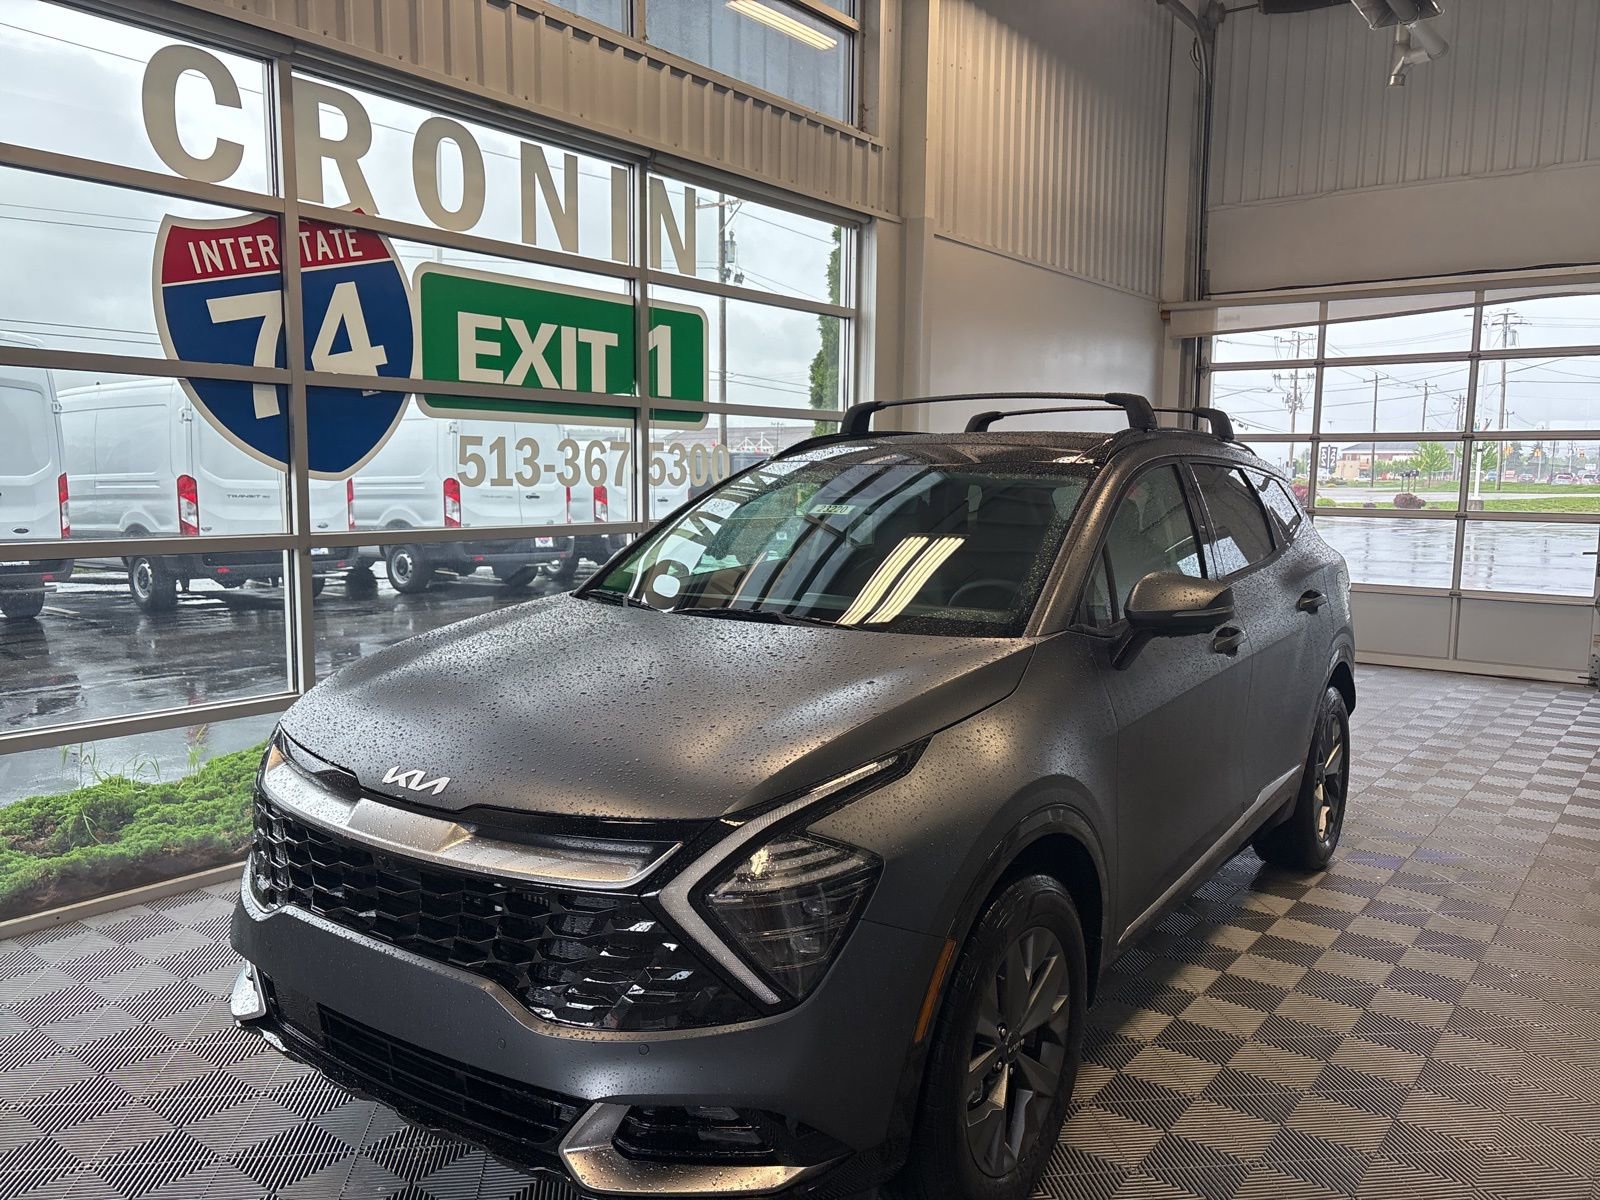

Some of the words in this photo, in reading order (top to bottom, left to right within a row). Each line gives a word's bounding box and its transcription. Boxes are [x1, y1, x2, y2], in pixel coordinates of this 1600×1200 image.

[142, 44, 697, 276] CRONIN
[187, 228, 364, 275] INTERTATE
[205, 281, 389, 420] 74
[457, 311, 619, 394] EXIT
[648, 324, 672, 398] 1
[457, 434, 731, 488] 513-3675300
[381, 765, 451, 796] KIA
